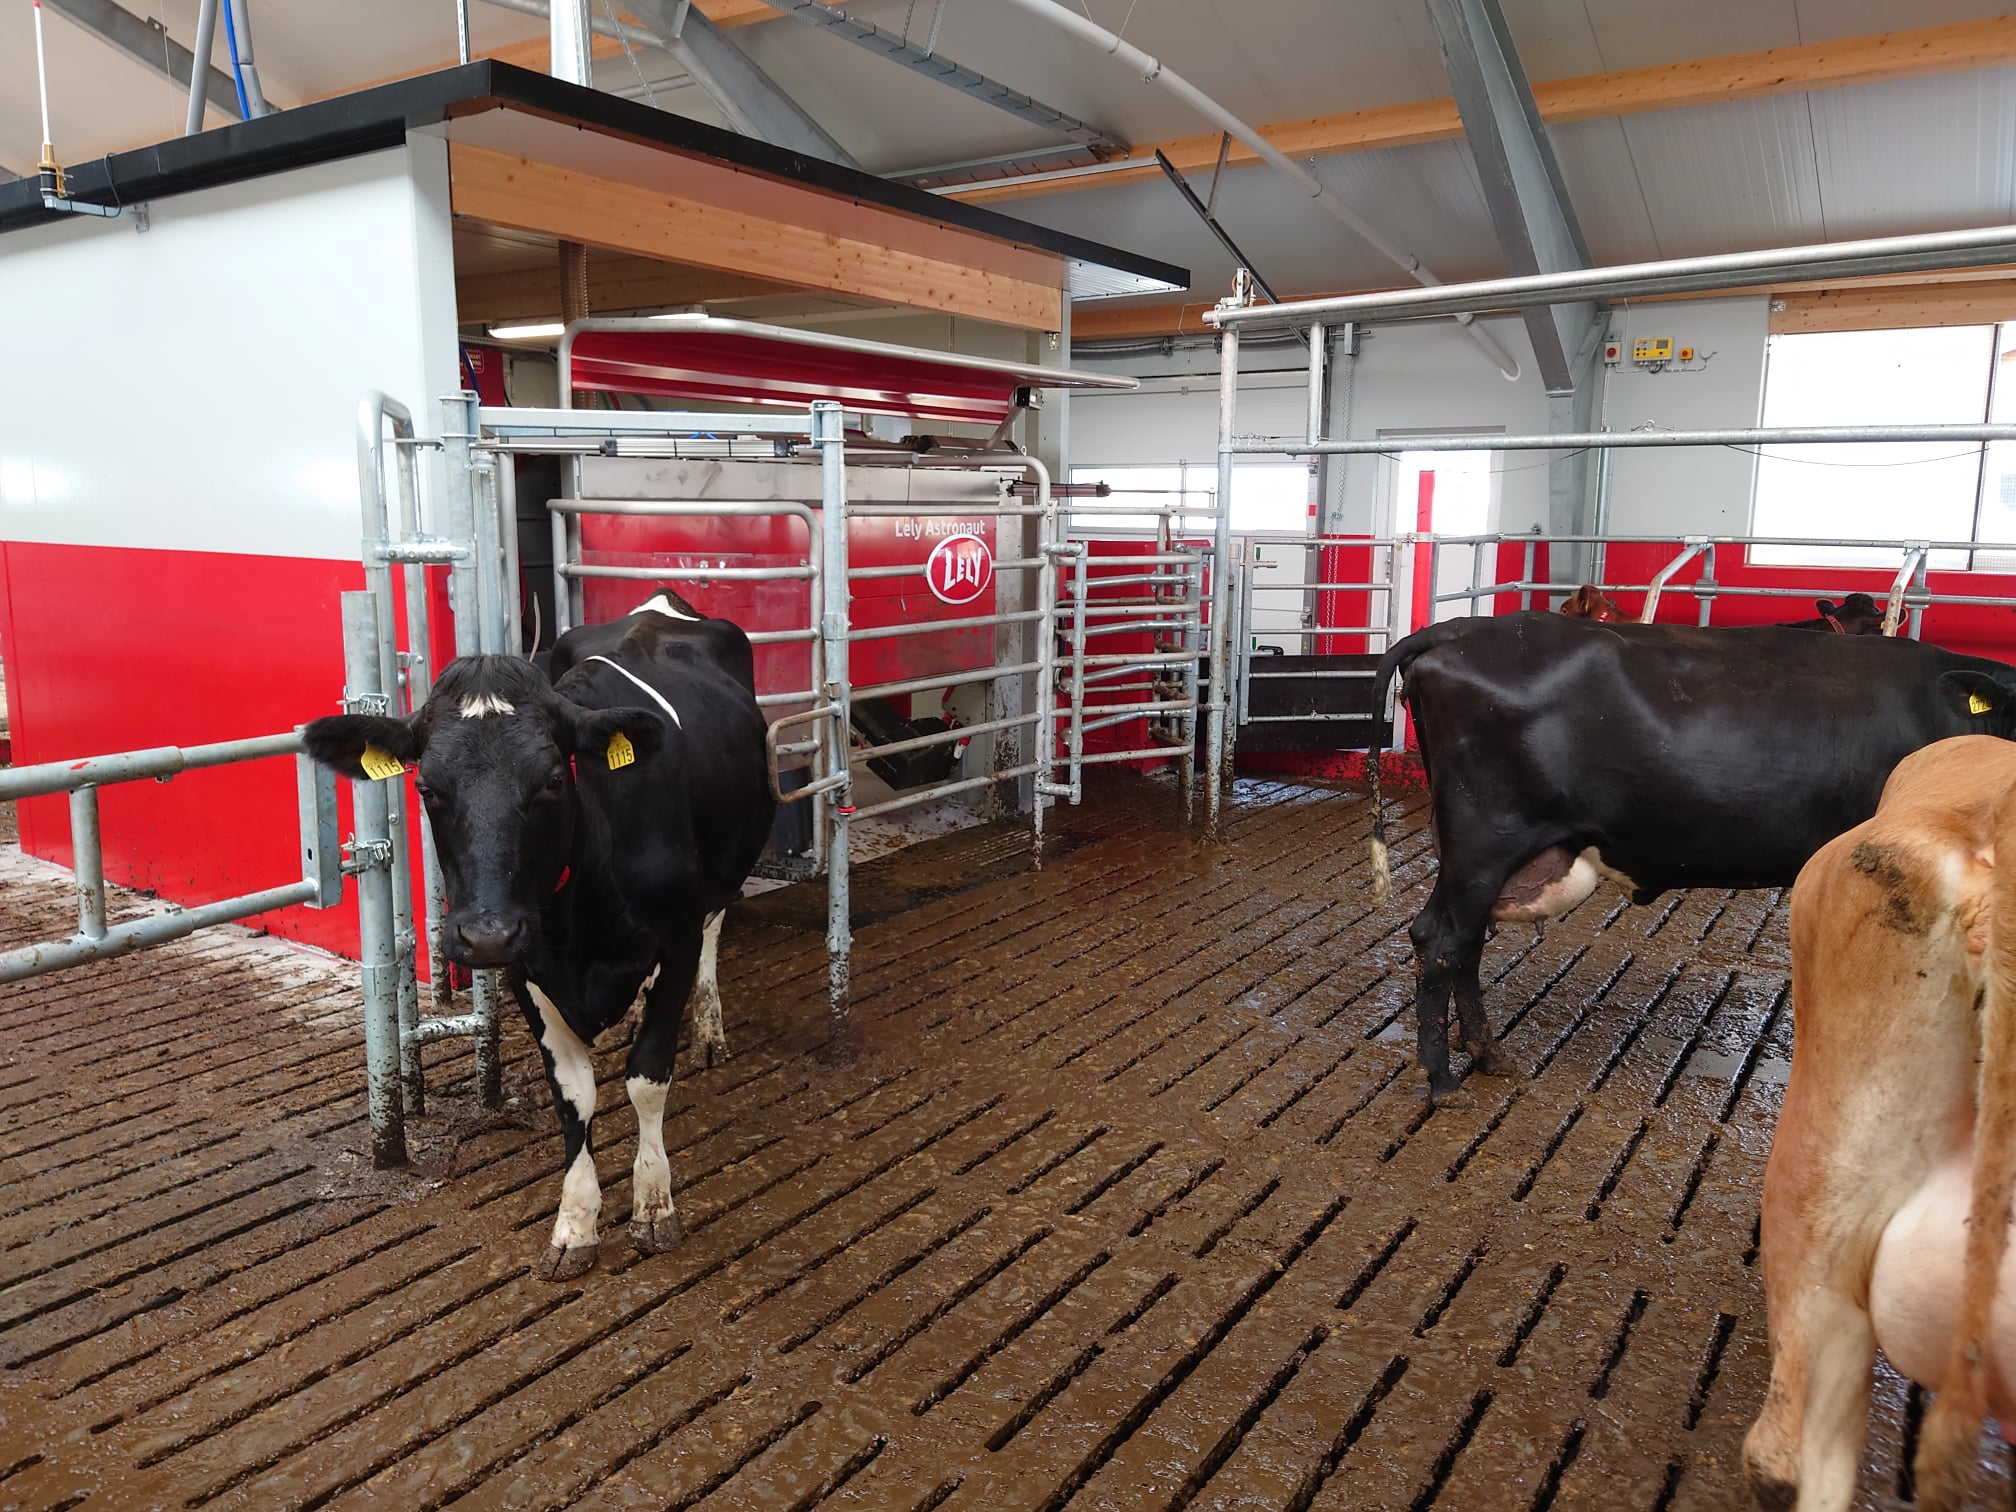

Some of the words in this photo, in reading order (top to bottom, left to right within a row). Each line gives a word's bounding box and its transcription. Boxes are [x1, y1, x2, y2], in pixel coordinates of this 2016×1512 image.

[895, 518, 922, 540] Lely
[925, 519, 986, 537] Astronaut
[943, 546, 982, 592] LELY
[370, 758, 401, 778] 1115
[609, 748, 633, 769] 1115
